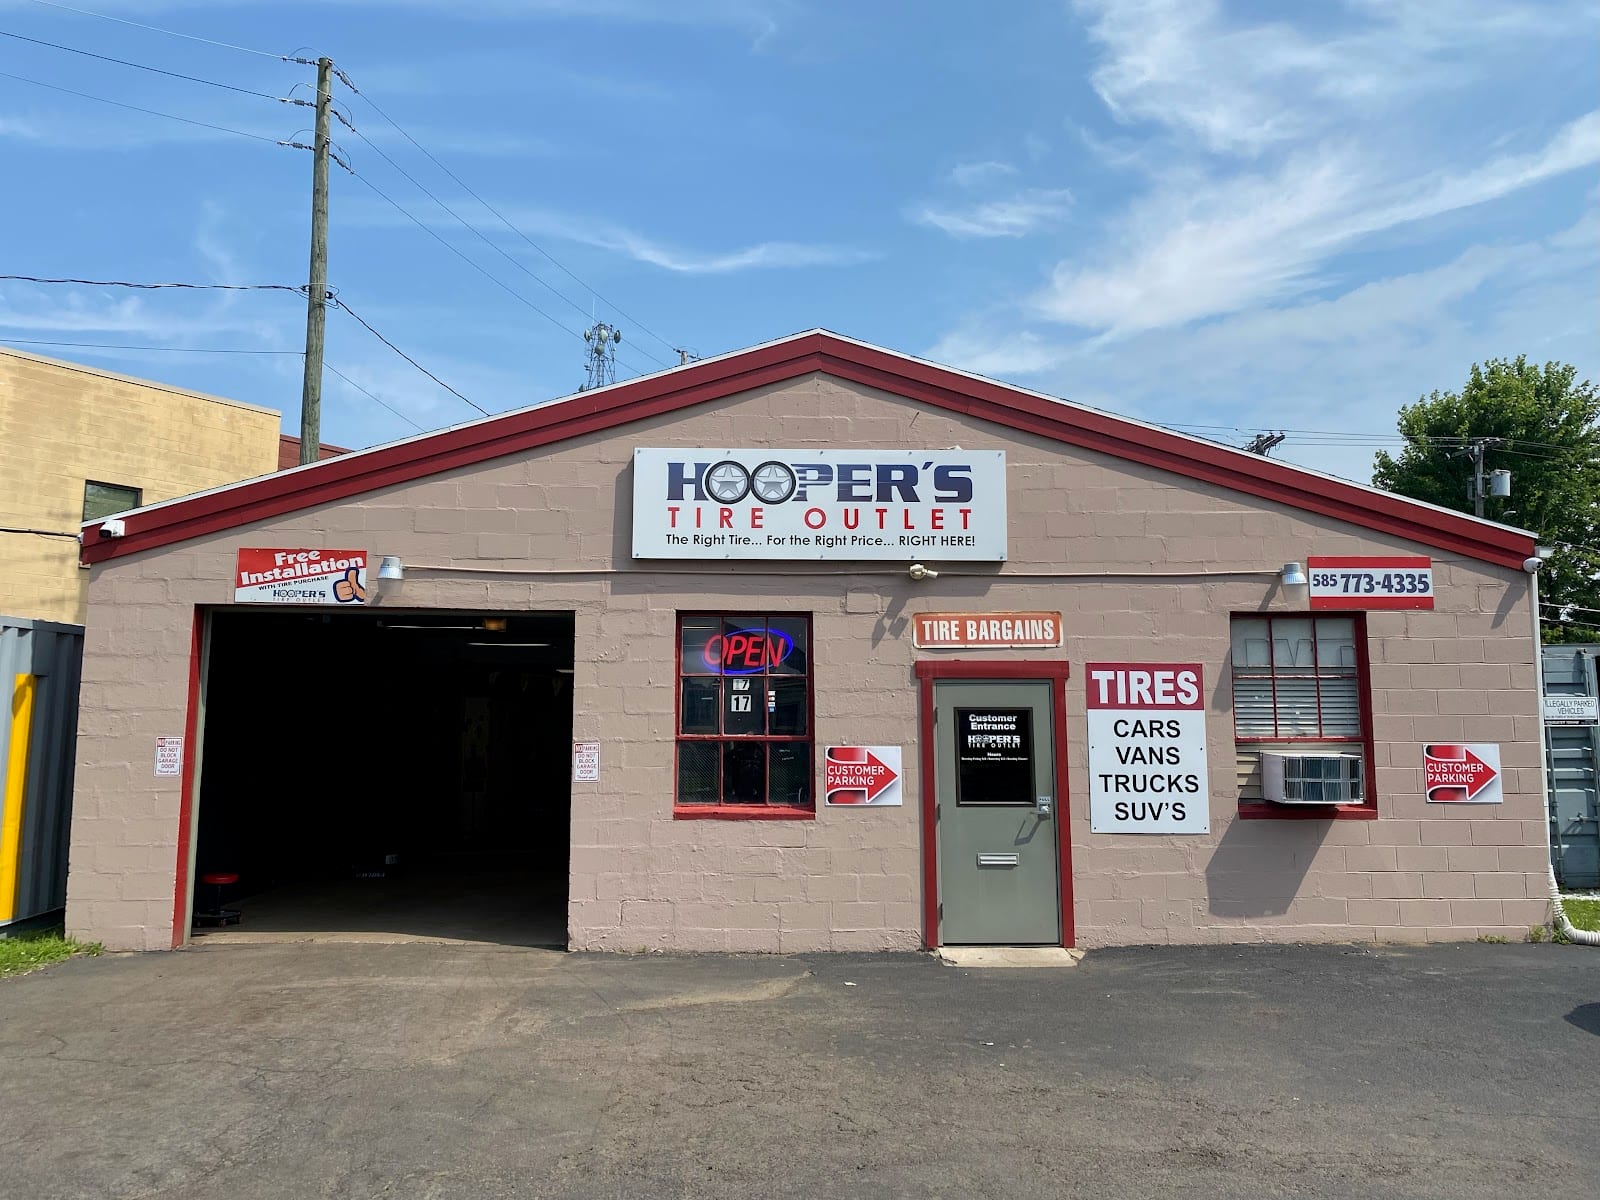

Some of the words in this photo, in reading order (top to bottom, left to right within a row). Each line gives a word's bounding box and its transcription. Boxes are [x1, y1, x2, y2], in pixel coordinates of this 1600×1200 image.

[666, 460, 973, 505] HOOPER'S
[668, 507, 764, 529] TIRE
[804, 507, 972, 530] OUTLET
[666, 534, 689, 545] The
[693, 534, 725, 548] Right
[728, 534, 762, 545] Tire...
[767, 535, 786, 546] For
[790, 535, 811, 546] the
[815, 535, 847, 549] Right
[851, 536, 894, 547] Price...
[899, 536, 936, 547] RIGHT
[941, 536, 975, 547] HERE!
[274, 550, 320, 566] Free
[240, 556, 364, 585] Installation
[294, 576, 328, 584] PURCHASE
[1312, 574, 1338, 586] 585
[1340, 574, 1430, 593] 773-4335
[273, 590, 326, 598] HOOPER'S
[922, 620, 960, 640] TIRE
[966, 619, 1054, 640] BARGAINS
[704, 634, 784, 667] OPEN
[1092, 670, 1198, 705] TIRES
[734, 696, 750, 710] 17
[1114, 720, 1180, 738] CARS
[968, 735, 1020, 744] HOOPER'S
[1116, 746, 1180, 764] VANS
[828, 766, 884, 775] CUSTOMER
[1427, 763, 1484, 772] CUSTOMER
[828, 776, 874, 785] PARKING
[1099, 774, 1198, 793] TRUCKS
[1428, 774, 1474, 782] PARKING
[1114, 802, 1186, 820] SUV'S
